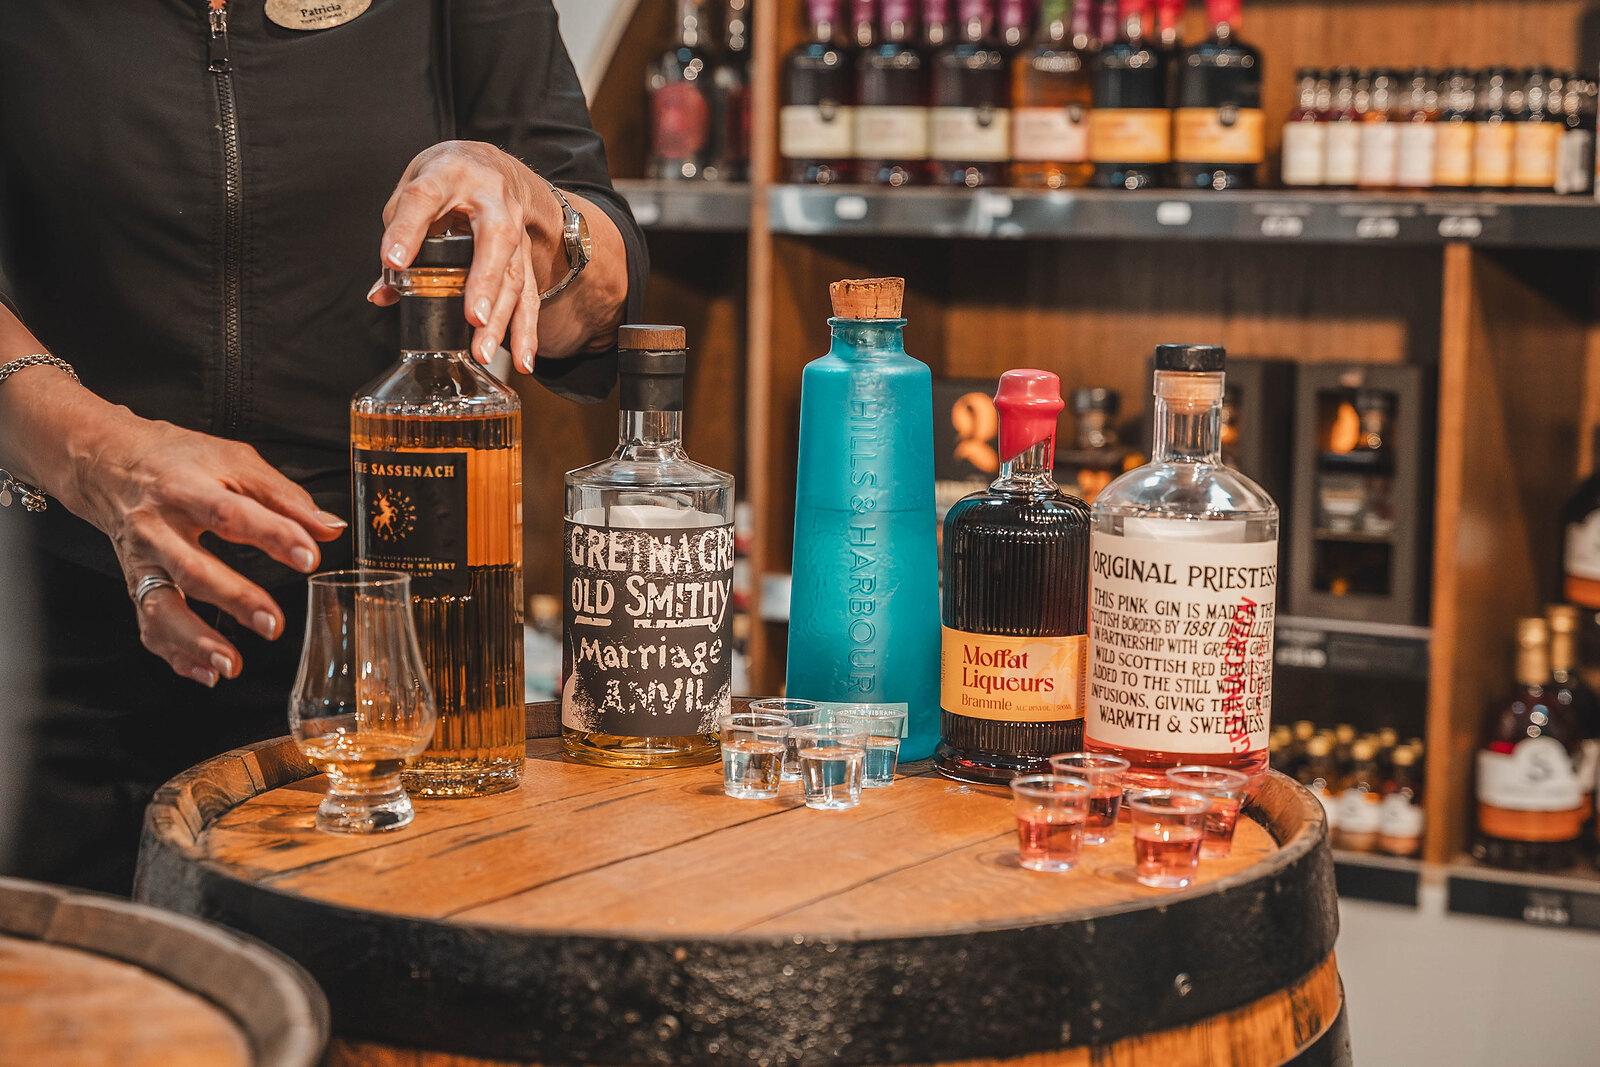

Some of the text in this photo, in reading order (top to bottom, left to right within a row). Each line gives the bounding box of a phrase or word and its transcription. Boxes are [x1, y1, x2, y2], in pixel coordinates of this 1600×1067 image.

[300, 3, 341, 17] Patricia
[850, 398, 877, 489] HILLS
[371, 464, 455, 478] SASSENACH
[850, 494, 877, 516] &
[571, 525, 693, 574] GRETNA
[379, 561, 414, 570] SCOTCH
[418, 562, 456, 571] WHISKY
[1093, 550, 1177, 585] ORIGINAL
[571, 575, 731, 633] OLD SMITHY
[848, 524, 876, 695] HARBOUR
[1094, 587, 1114, 609] THIS
[1118, 595, 1148, 614] PINK
[1155, 600, 1181, 617] GIN
[1187, 603, 1201, 619] IS
[1206, 604, 1244, 619] MADE
[1261, 602, 1273, 618] THE
[1094, 626, 1100, 640] IN
[1101, 628, 1164, 652] PARTNERSHIP
[1168, 639, 1198, 654] WITH
[1122, 615, 1161, 635] BORDERS
[1165, 620, 1180, 634] BY
[578, 634, 723, 675] Marriage
[963, 644, 1029, 669] Moffat
[1096, 645, 1115, 664] WILD
[1118, 652, 1187, 674] SCOTTISH
[1192, 662, 1215, 678] RED
[963, 667, 1054, 694] Liqueurs
[1093, 663, 1117, 683] ADDED
[1121, 671, 1138, 687] TO
[1143, 675, 1170, 692] THE
[1175, 678, 1211, 694] STILL
[1217, 679, 1246, 694] WITH
[598, 677, 708, 715] ANVIL
[962, 693, 1012, 710] Brammle
[1155, 695, 1204, 712] GIVING
[1211, 698, 1241, 712] THIS
[1099, 704, 1264, 735] WARMTH & SWEETNESS
